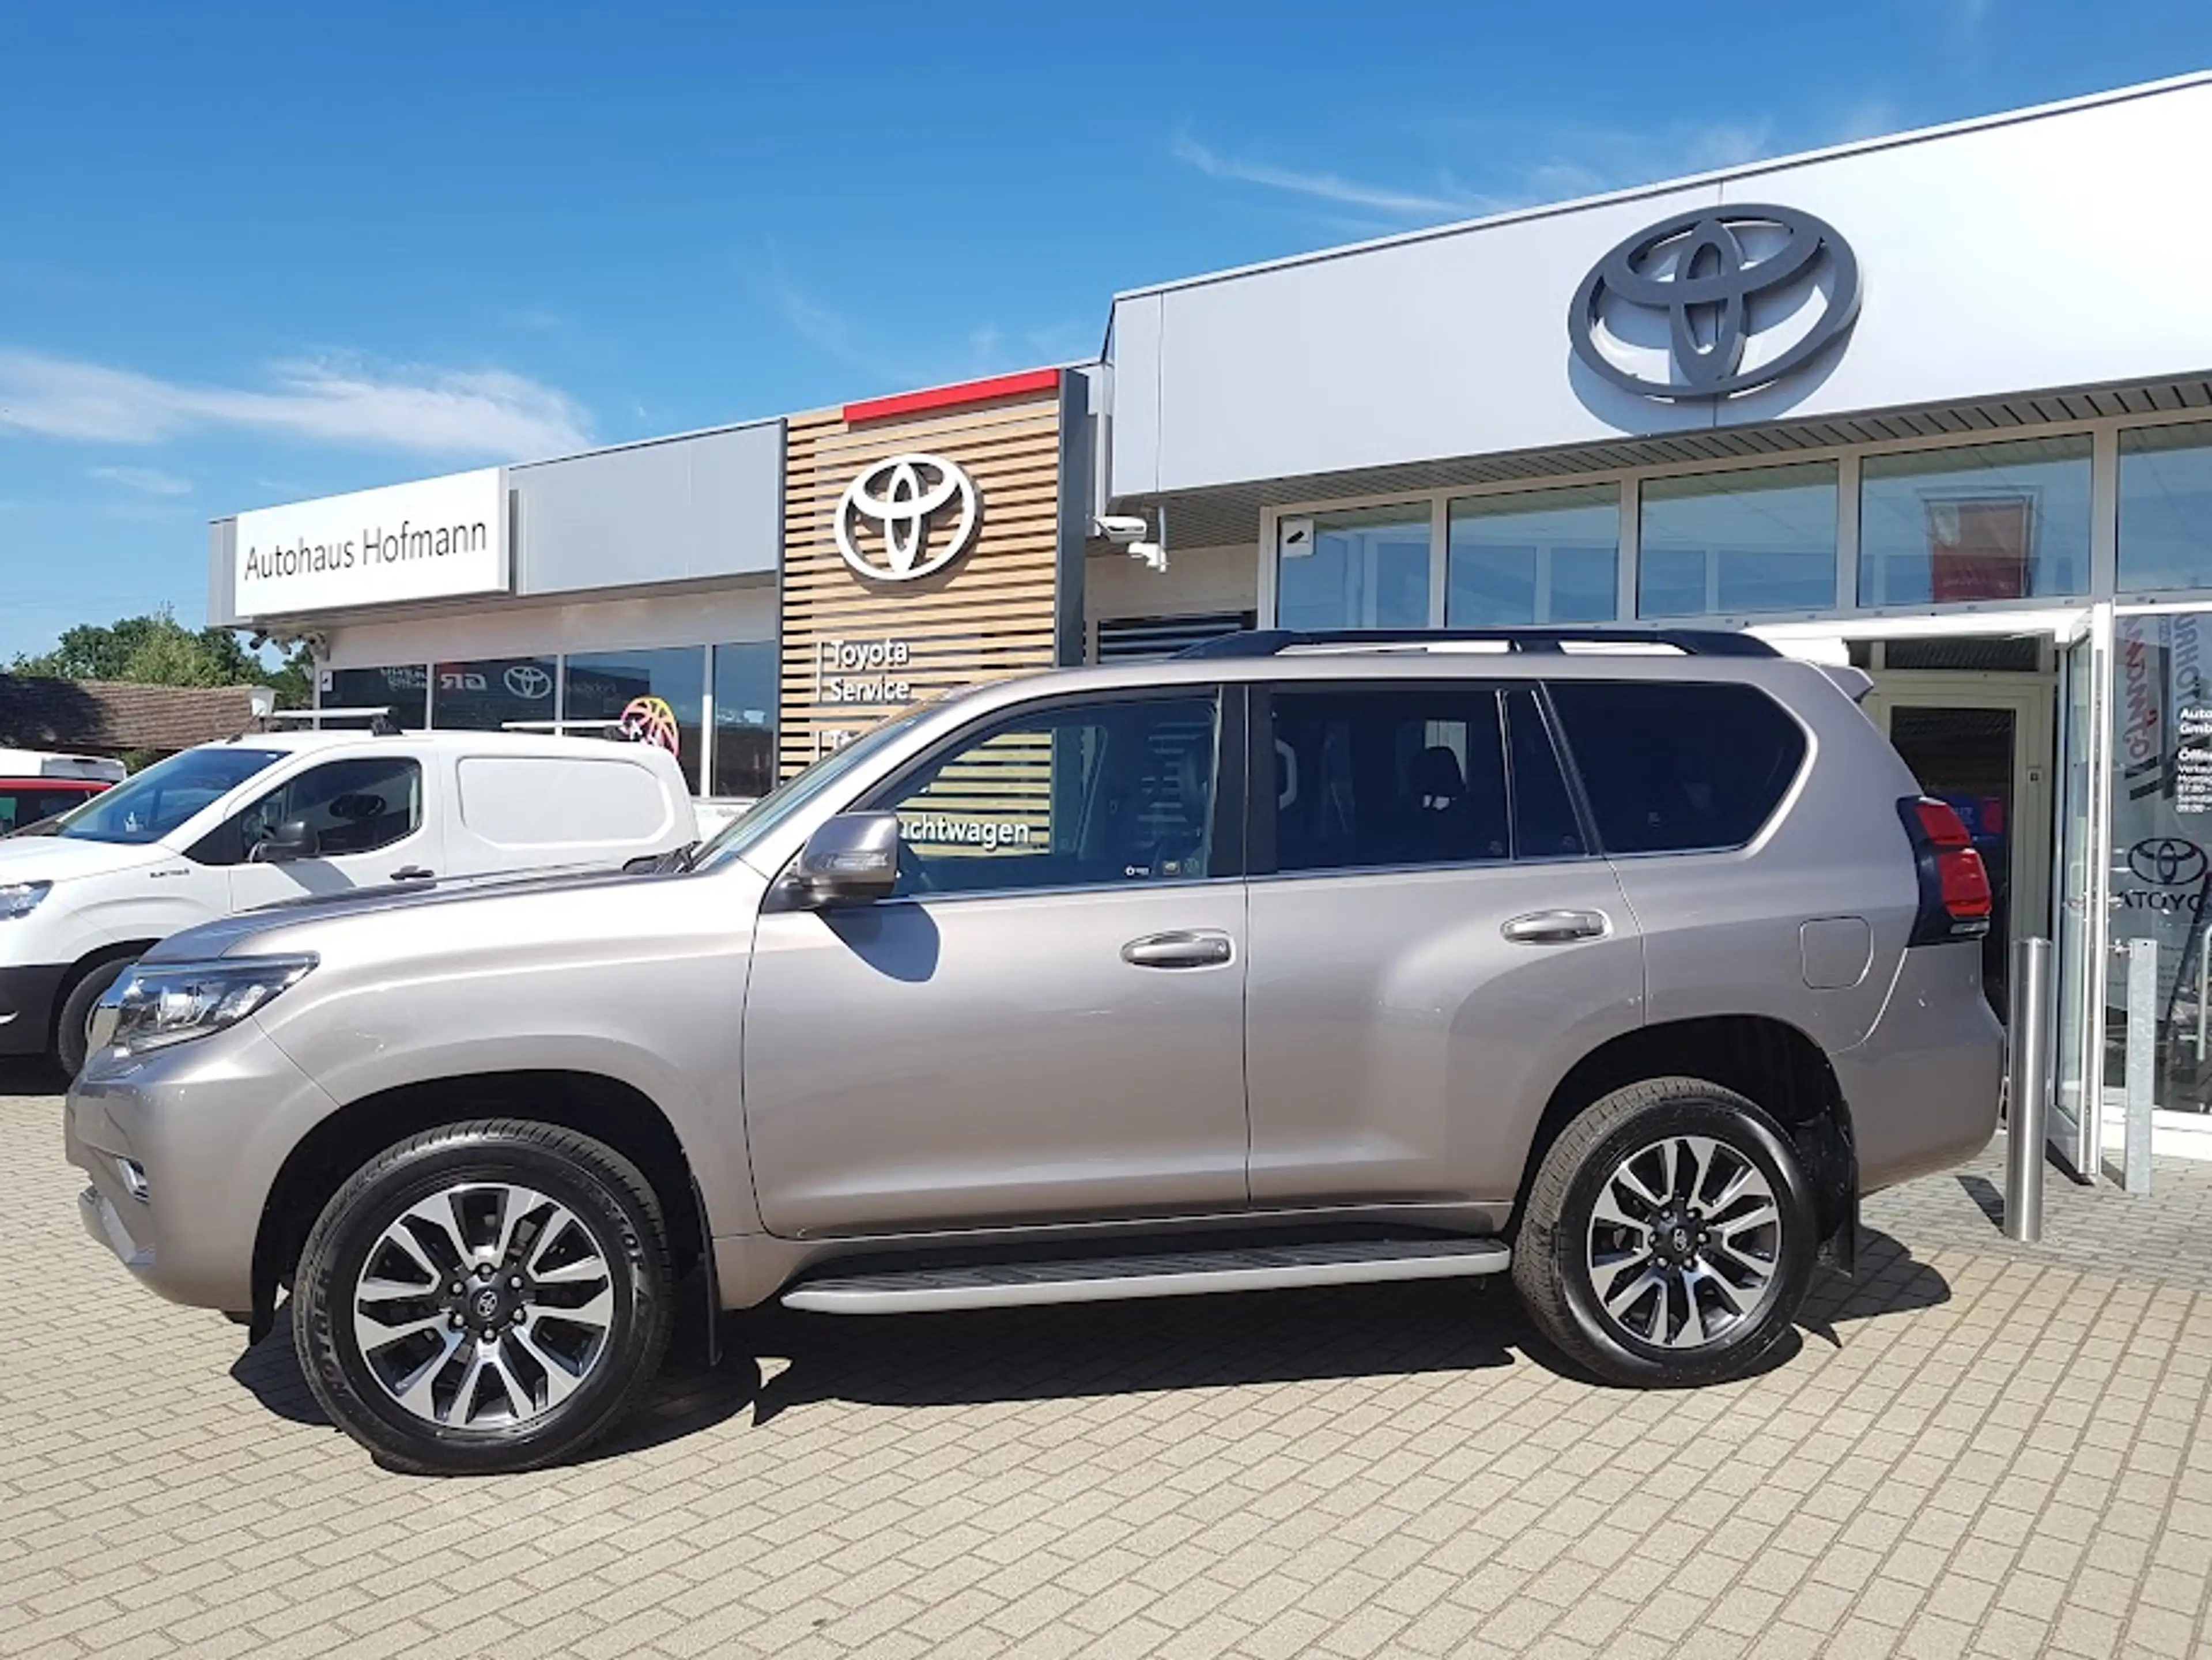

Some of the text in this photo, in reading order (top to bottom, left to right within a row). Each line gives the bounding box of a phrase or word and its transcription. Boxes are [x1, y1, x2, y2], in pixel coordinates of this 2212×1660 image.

[244, 520, 486, 580] Autohaus Hofmann
[831, 639, 908, 670] Toyota
[831, 678, 910, 701] Service
